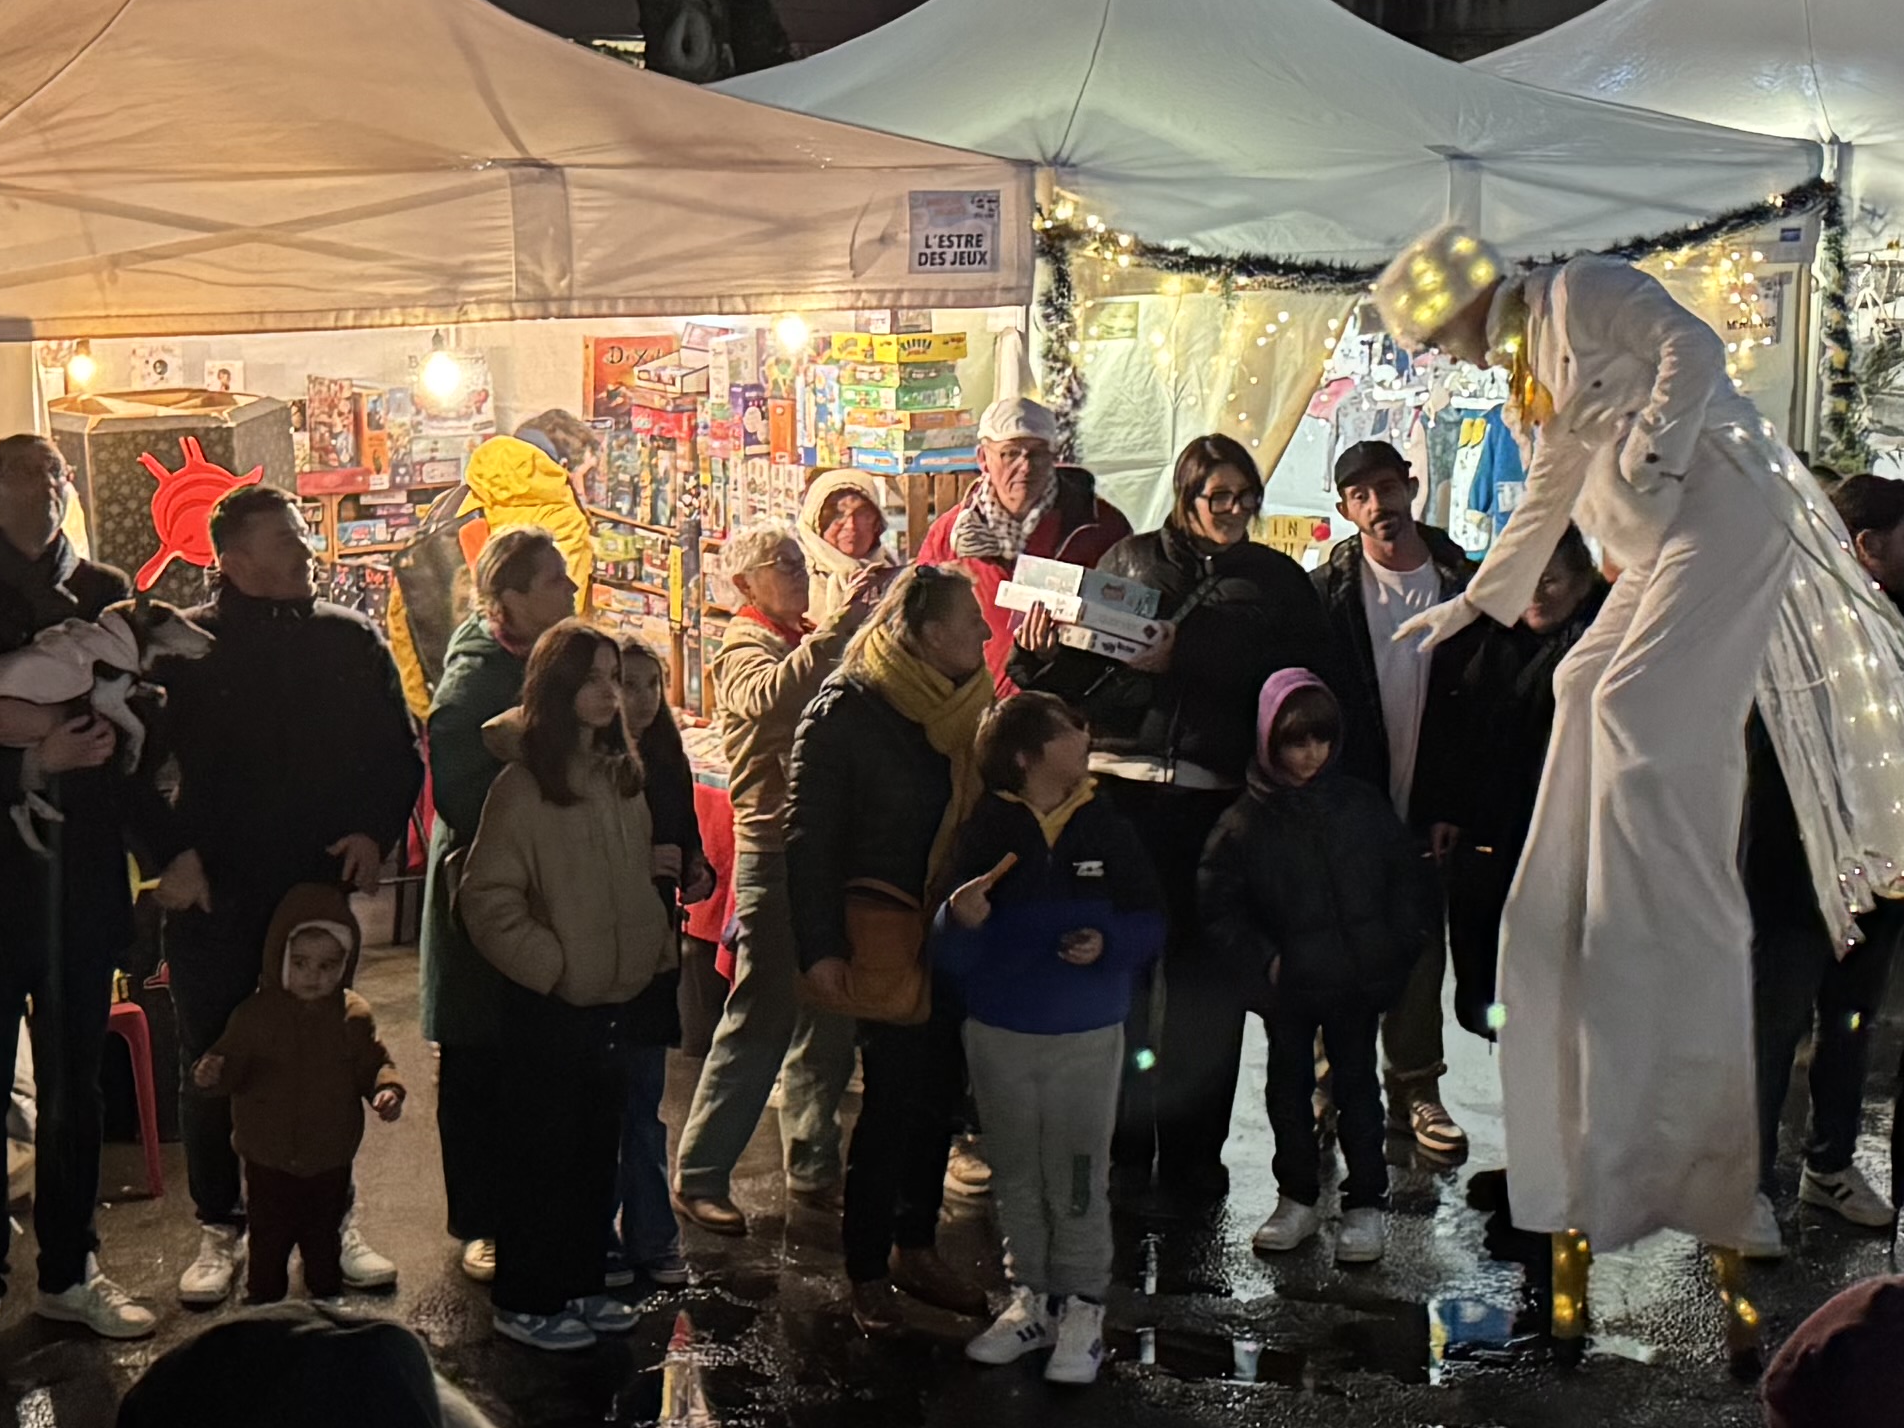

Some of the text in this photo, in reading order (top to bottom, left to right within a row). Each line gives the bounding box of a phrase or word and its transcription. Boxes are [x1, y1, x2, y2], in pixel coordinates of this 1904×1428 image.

[924, 234, 983, 249] L'ESTRE
[918, 250, 988, 266] DES JEUX
